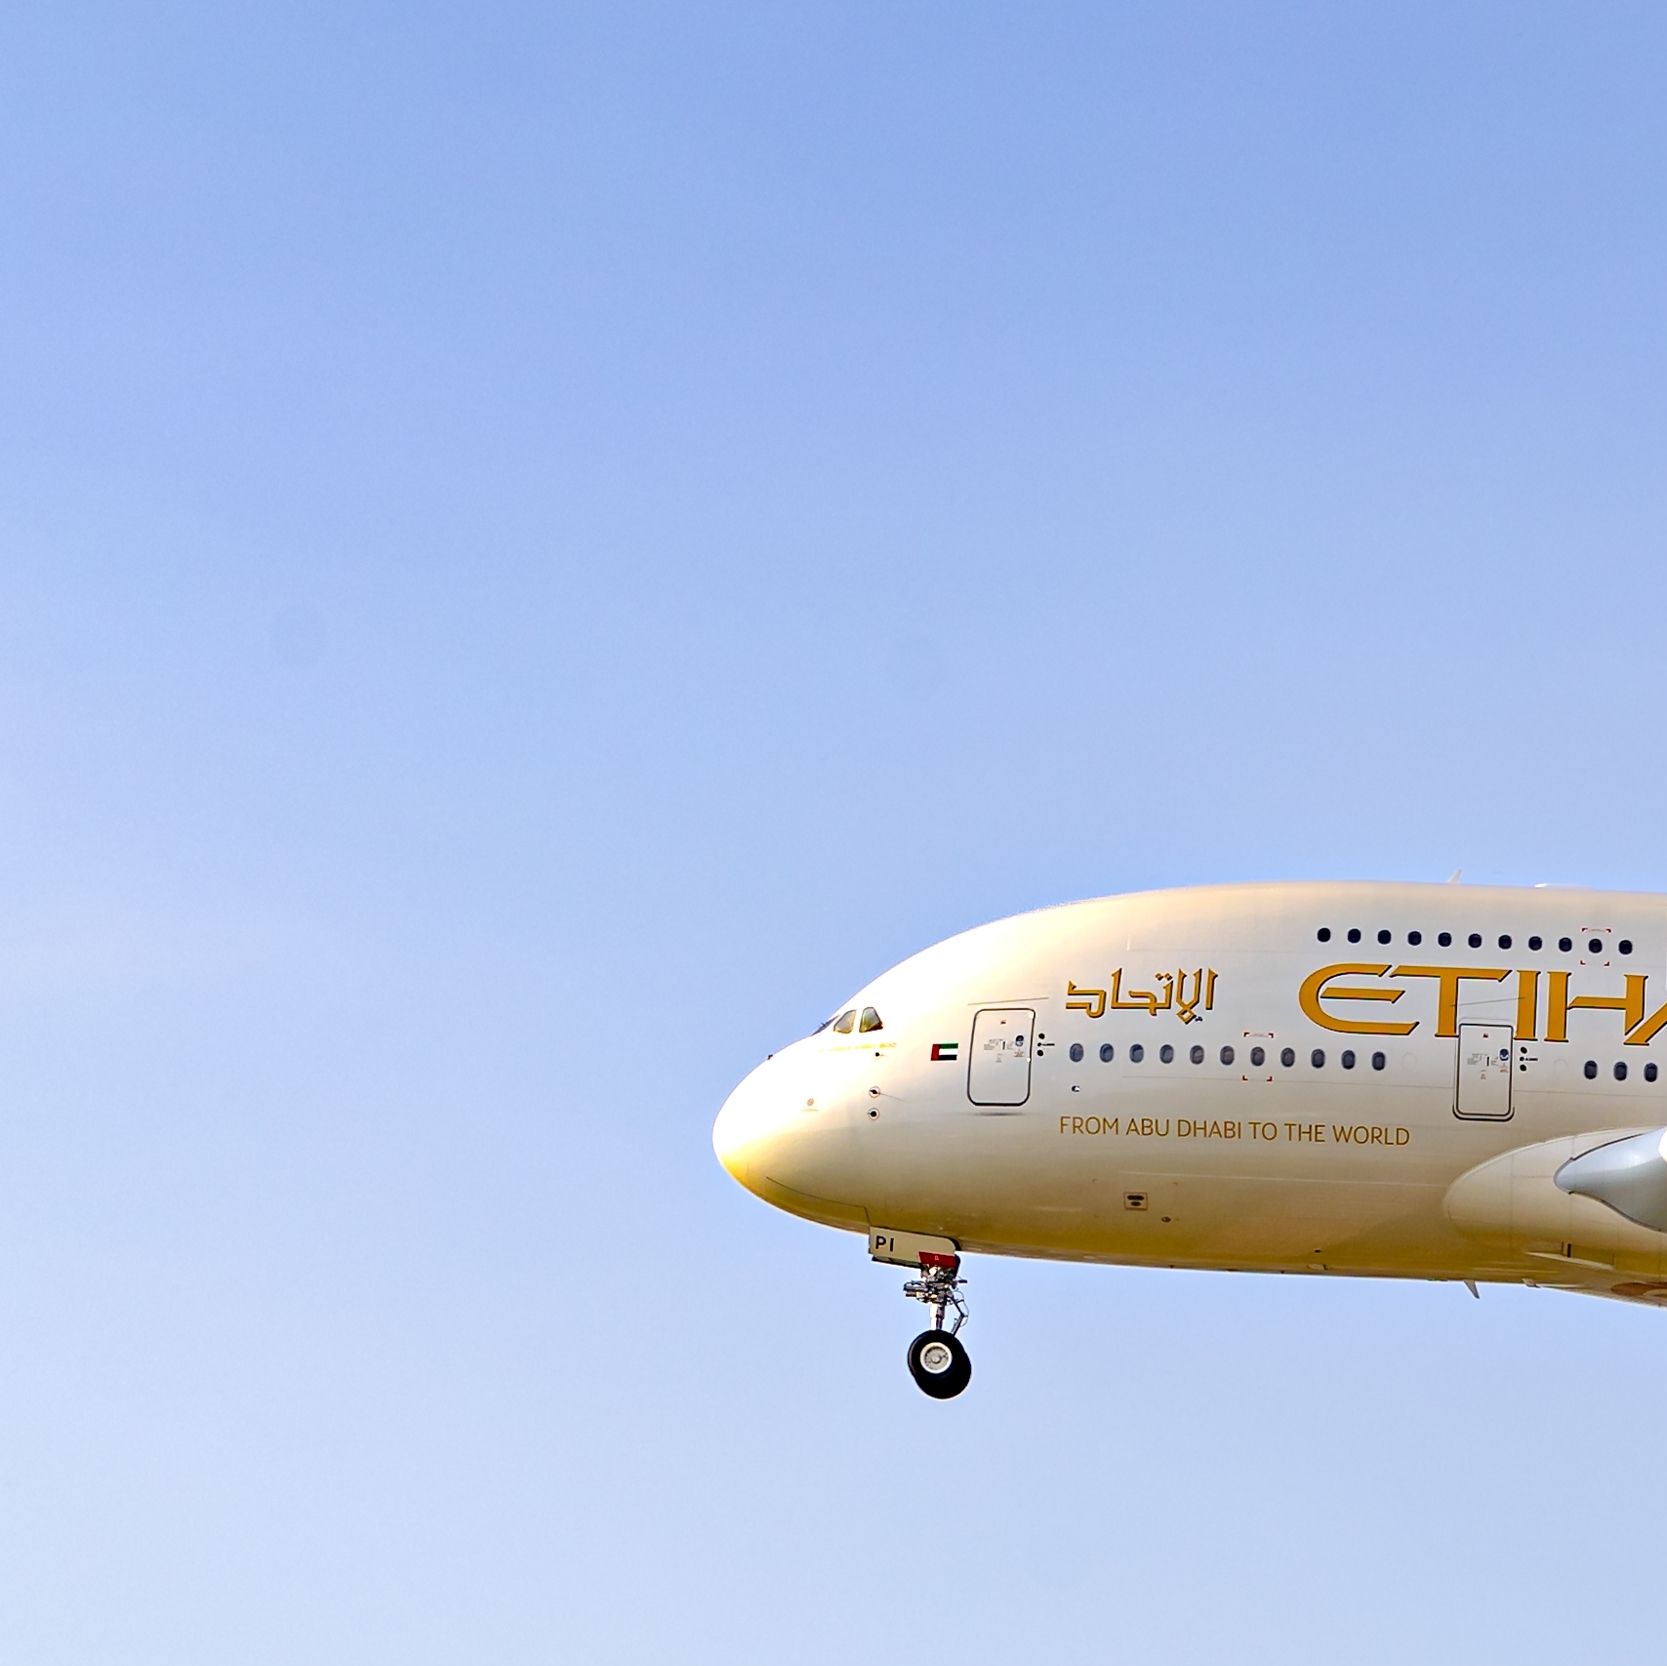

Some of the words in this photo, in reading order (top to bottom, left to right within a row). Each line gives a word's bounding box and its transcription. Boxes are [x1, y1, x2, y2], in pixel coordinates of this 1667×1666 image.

[1060, 1116, 1120, 1136] FROM
[1125, 1118, 1170, 1138] ABU
[1176, 1119, 1242, 1140] DHABI
[1249, 1121, 1278, 1141] TO
[1284, 1123, 1326, 1143] THE
[1332, 1125, 1410, 1146] WORLD
[875, 1235, 895, 1252] PI
